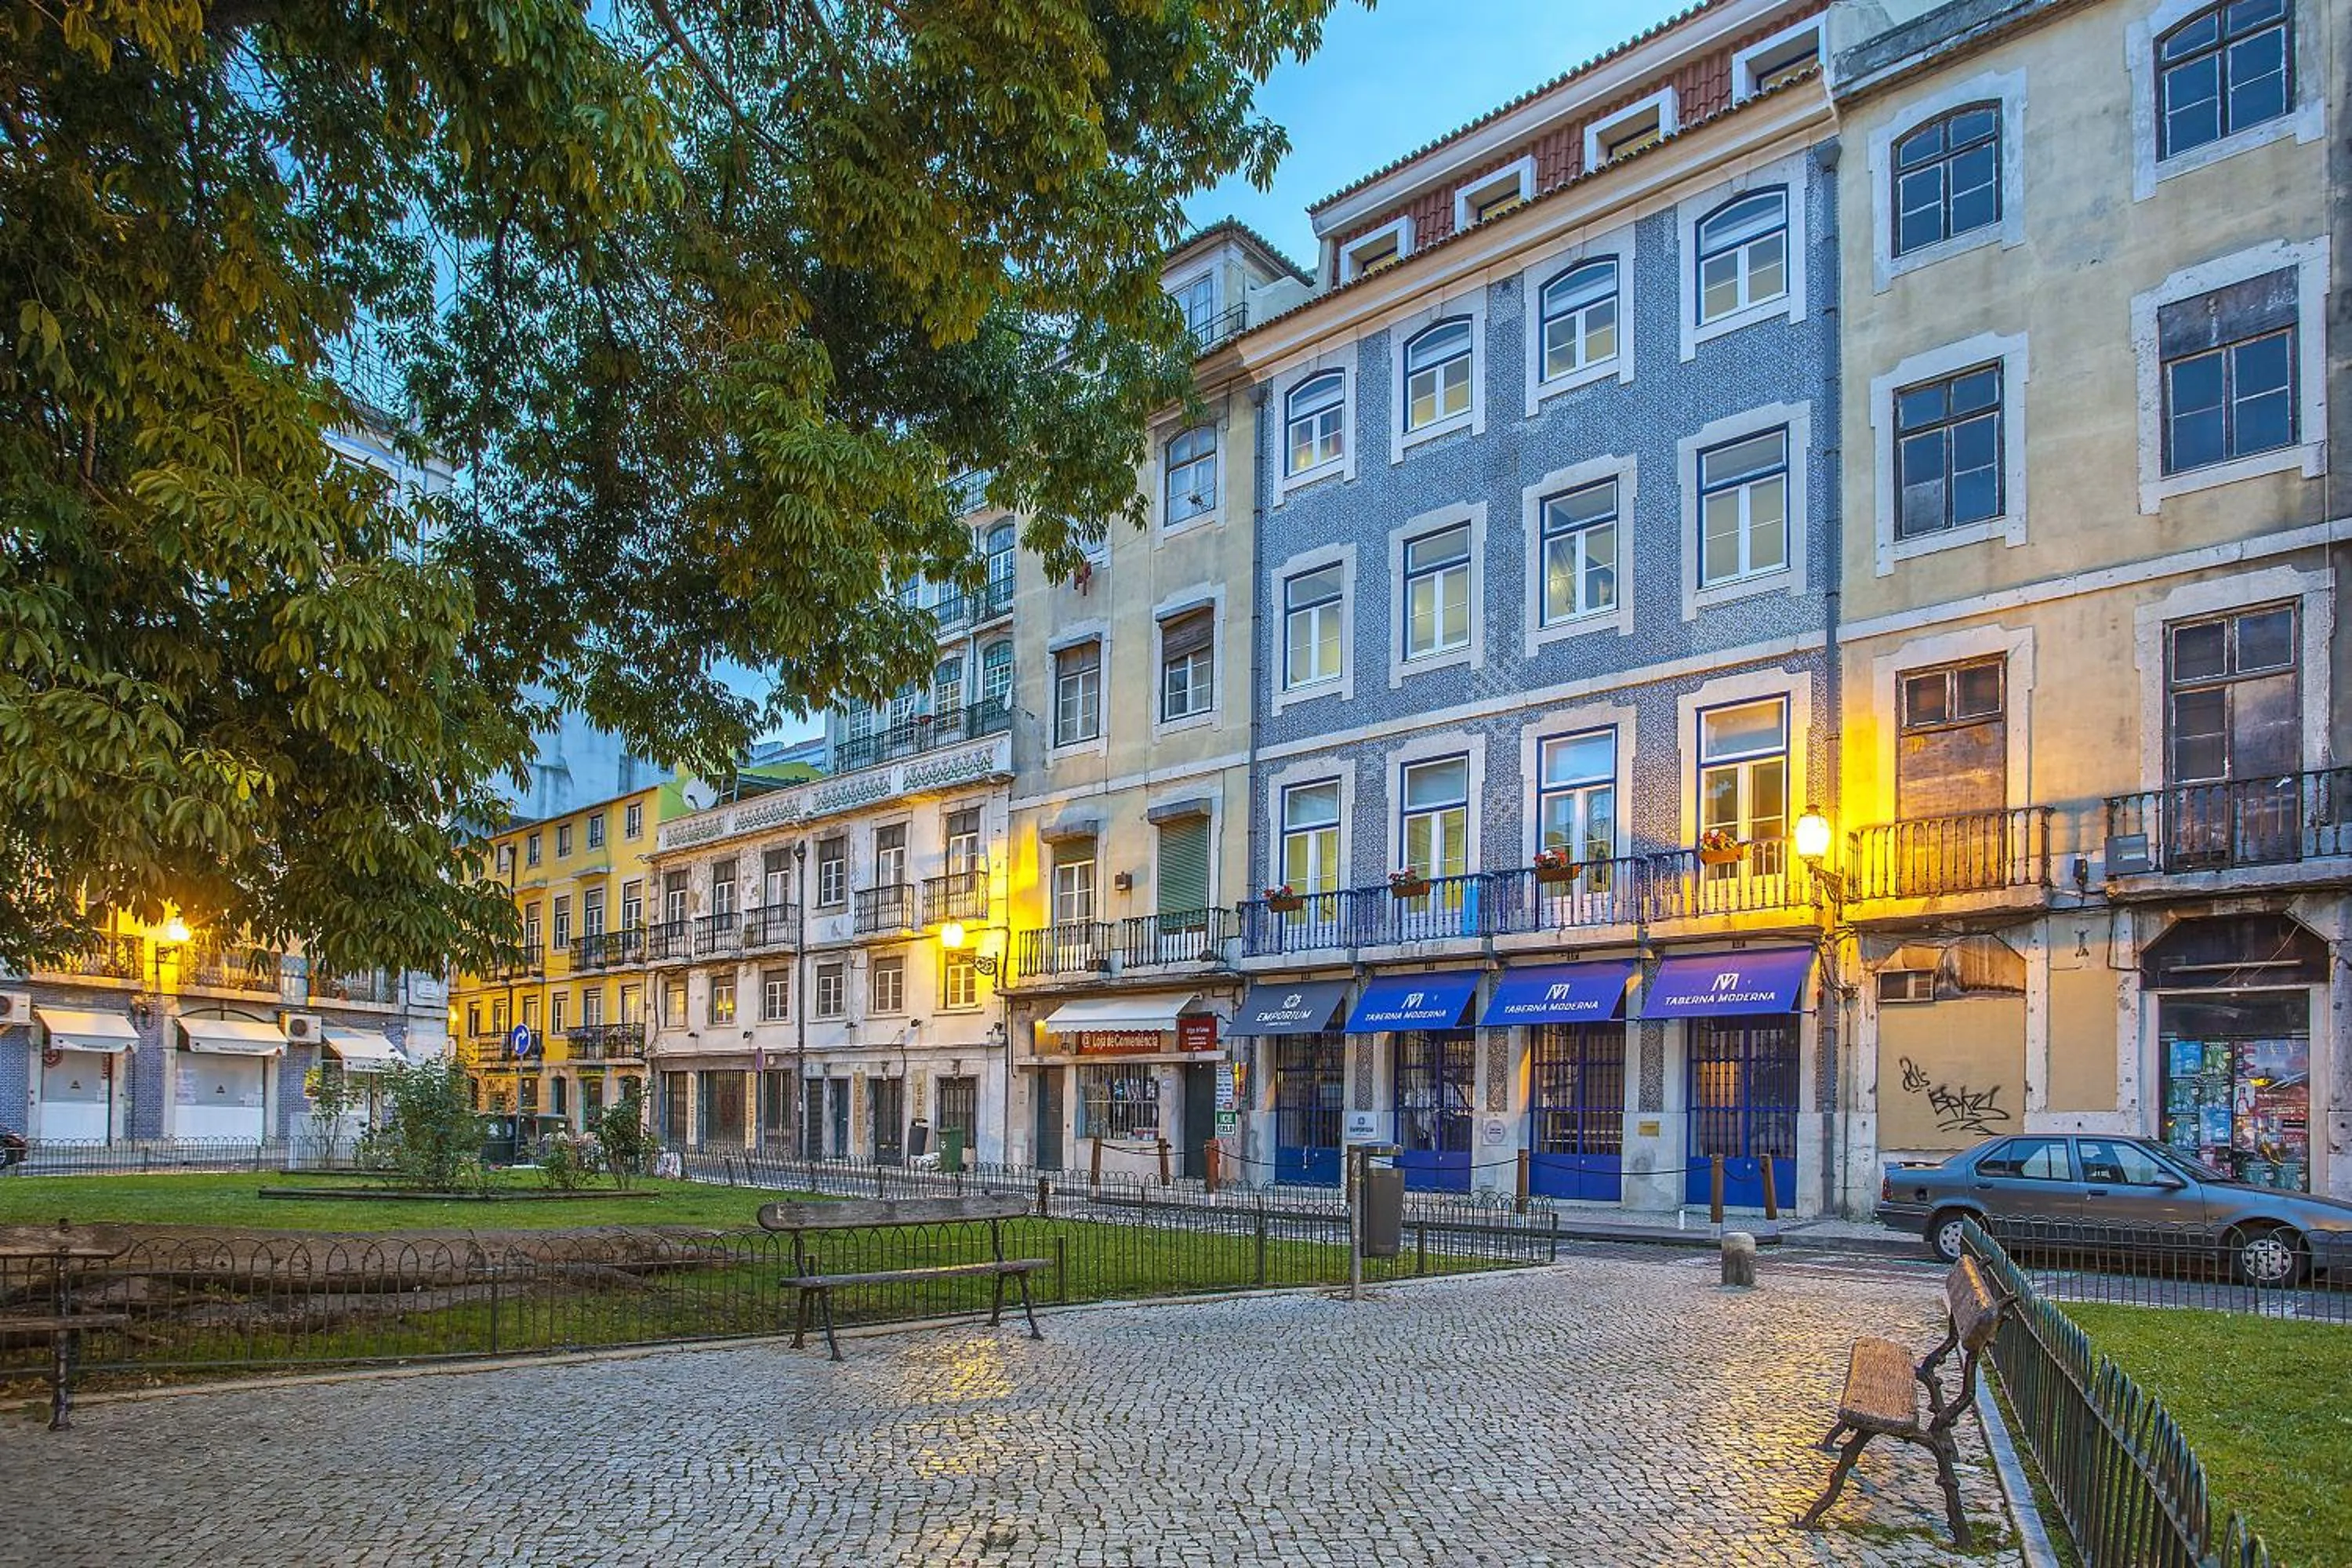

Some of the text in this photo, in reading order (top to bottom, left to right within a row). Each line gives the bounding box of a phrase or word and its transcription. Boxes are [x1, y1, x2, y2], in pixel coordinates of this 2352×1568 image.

[1665, 991, 1776, 1006] TABERNA MODERNA
[1504, 1000, 1599, 1014] TABERNA MODERNA
[1255, 1009, 1313, 1022] EMPORIUM
[1364, 1009, 1446, 1022] TABERNA MODERNA
[1092, 1033, 1106, 1051] Loja
